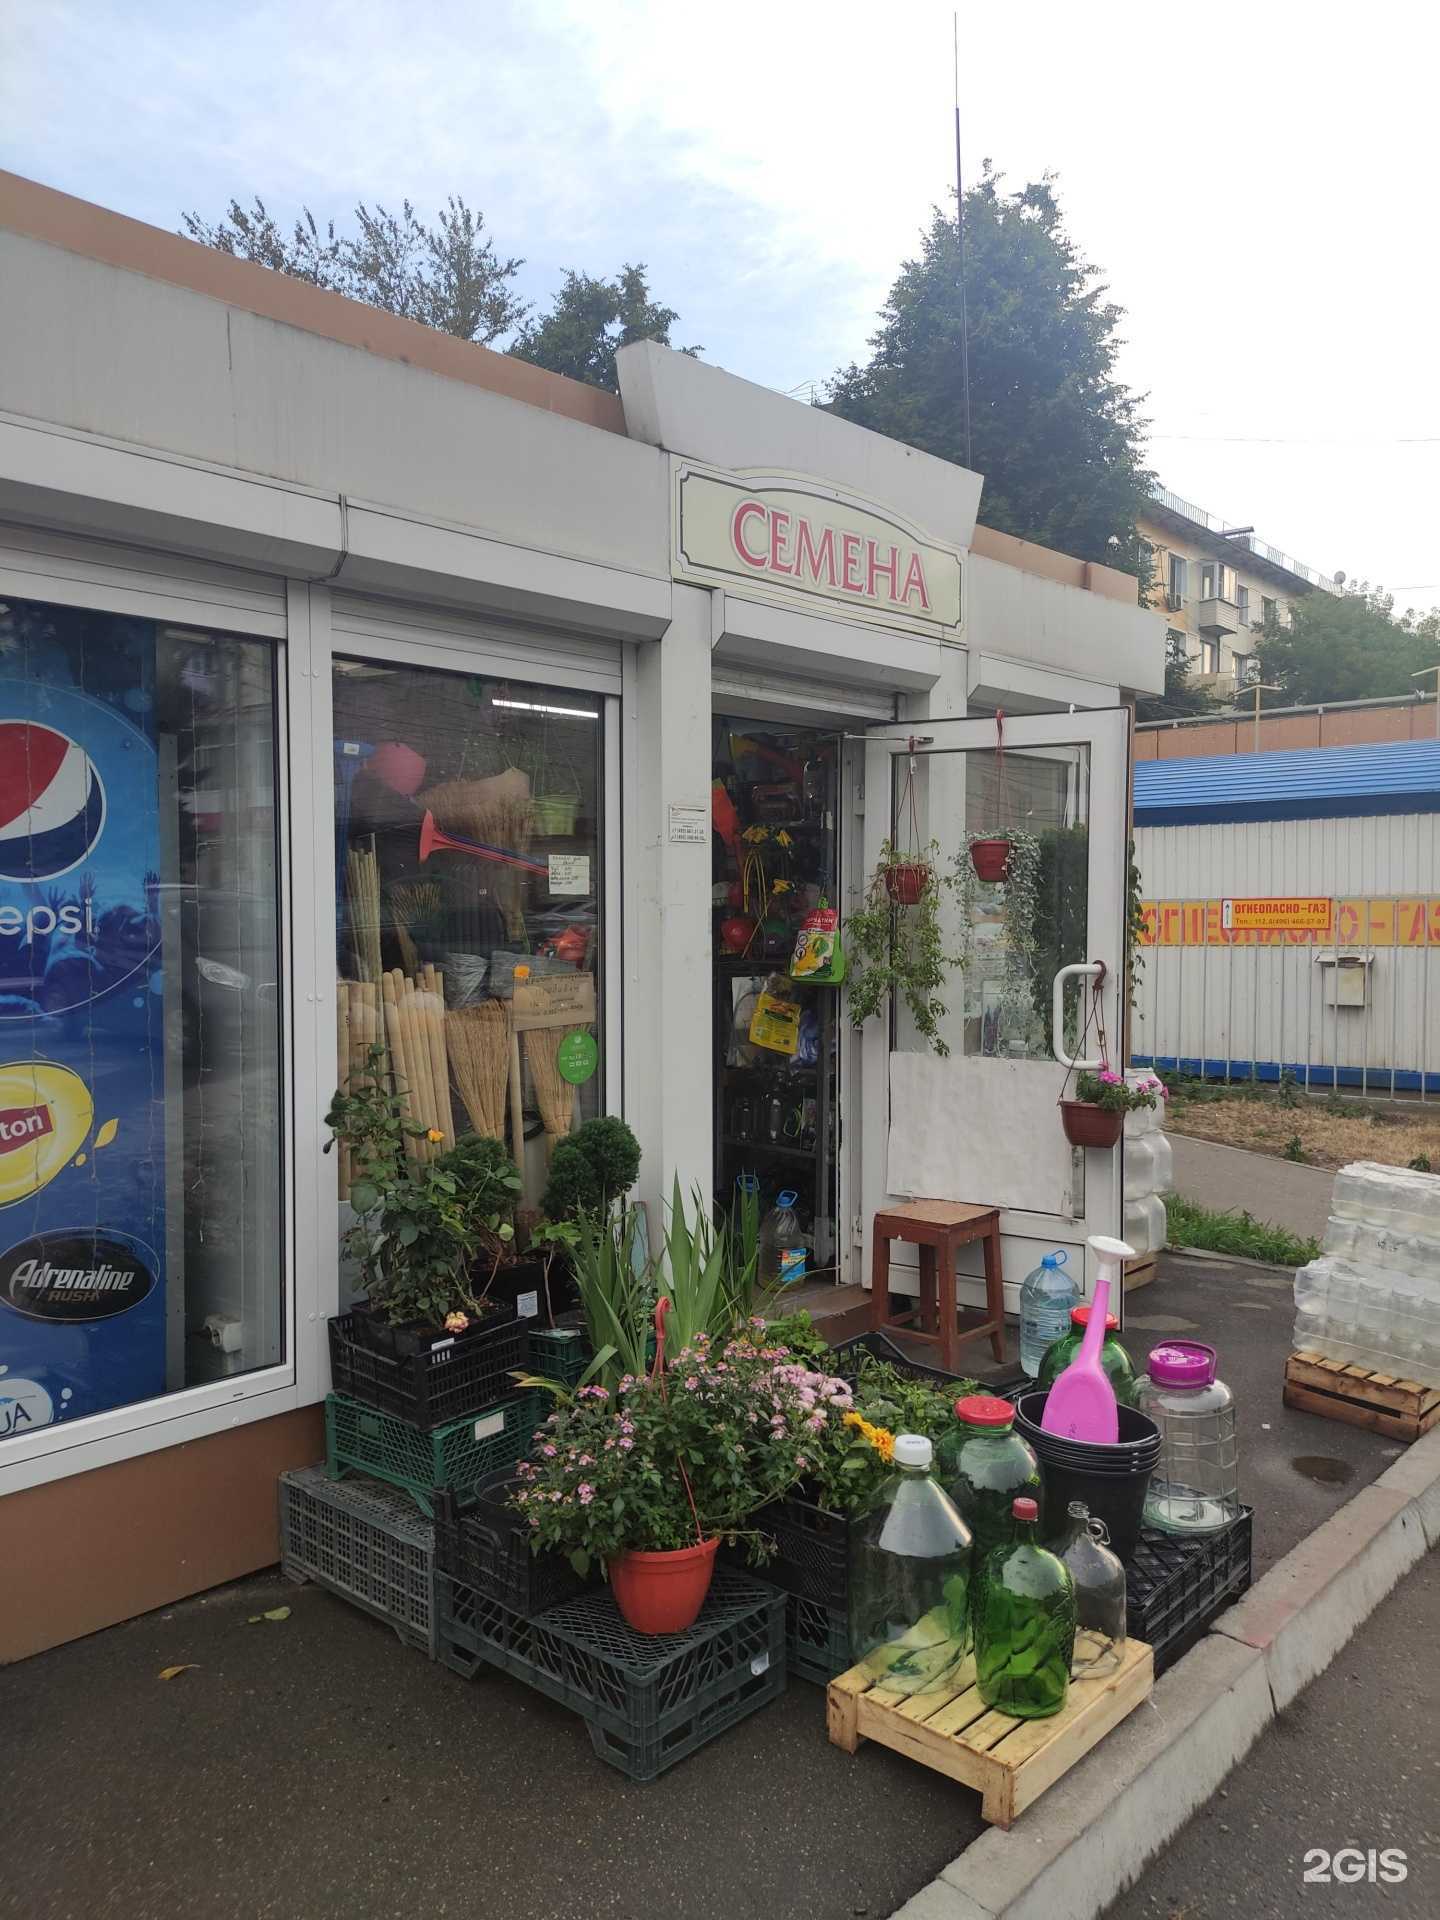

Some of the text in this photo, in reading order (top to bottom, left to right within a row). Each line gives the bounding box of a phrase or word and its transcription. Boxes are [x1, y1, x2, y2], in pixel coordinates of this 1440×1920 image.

[733, 501, 930, 610] СЕМЕНА
[9, 1259, 135, 1298] Adrenaline
[48, 1290, 97, 1302] RUSH
